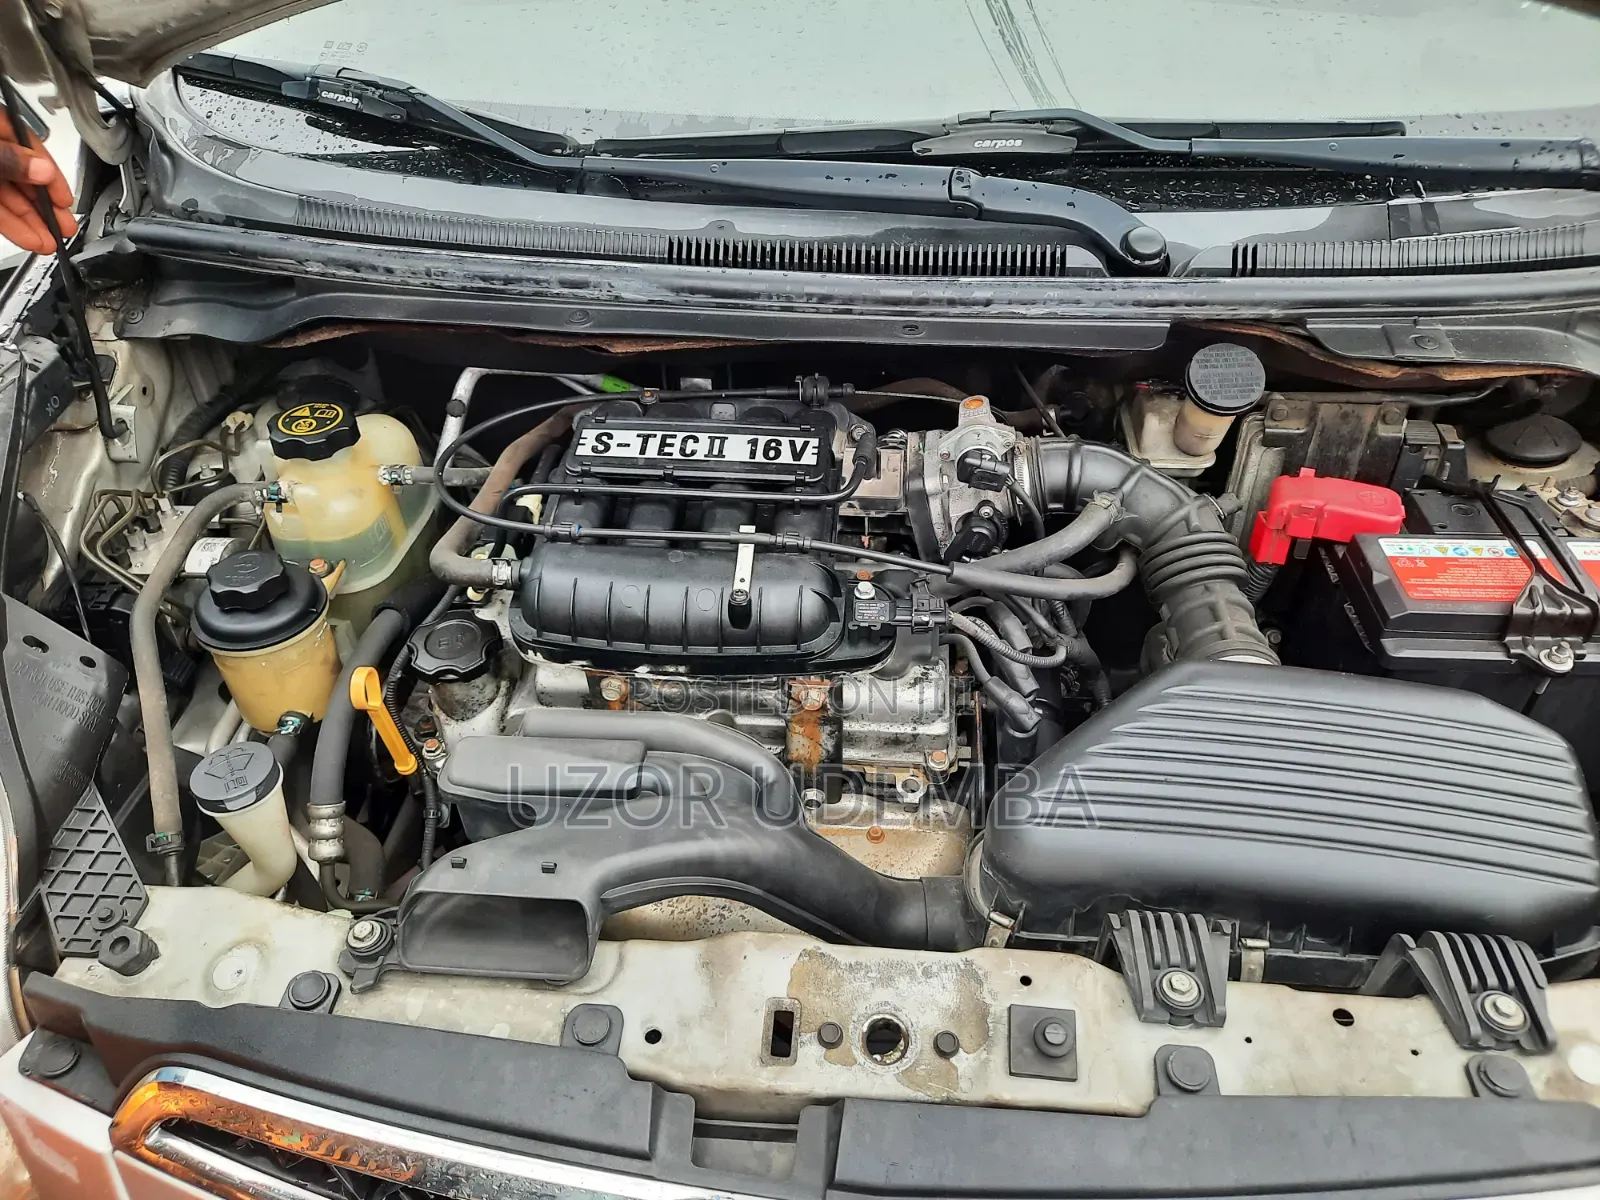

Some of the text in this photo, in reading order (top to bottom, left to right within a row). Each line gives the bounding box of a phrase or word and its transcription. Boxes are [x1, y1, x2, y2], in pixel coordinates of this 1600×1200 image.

[320, 90, 360, 105] carpos
[973, 138, 1023, 149] carpos
[746, 438, 812, 463] 16V
[46, 675, 69, 695] USE
[67, 685, 88, 704] THIS
[51, 698, 80, 721] HOOD
